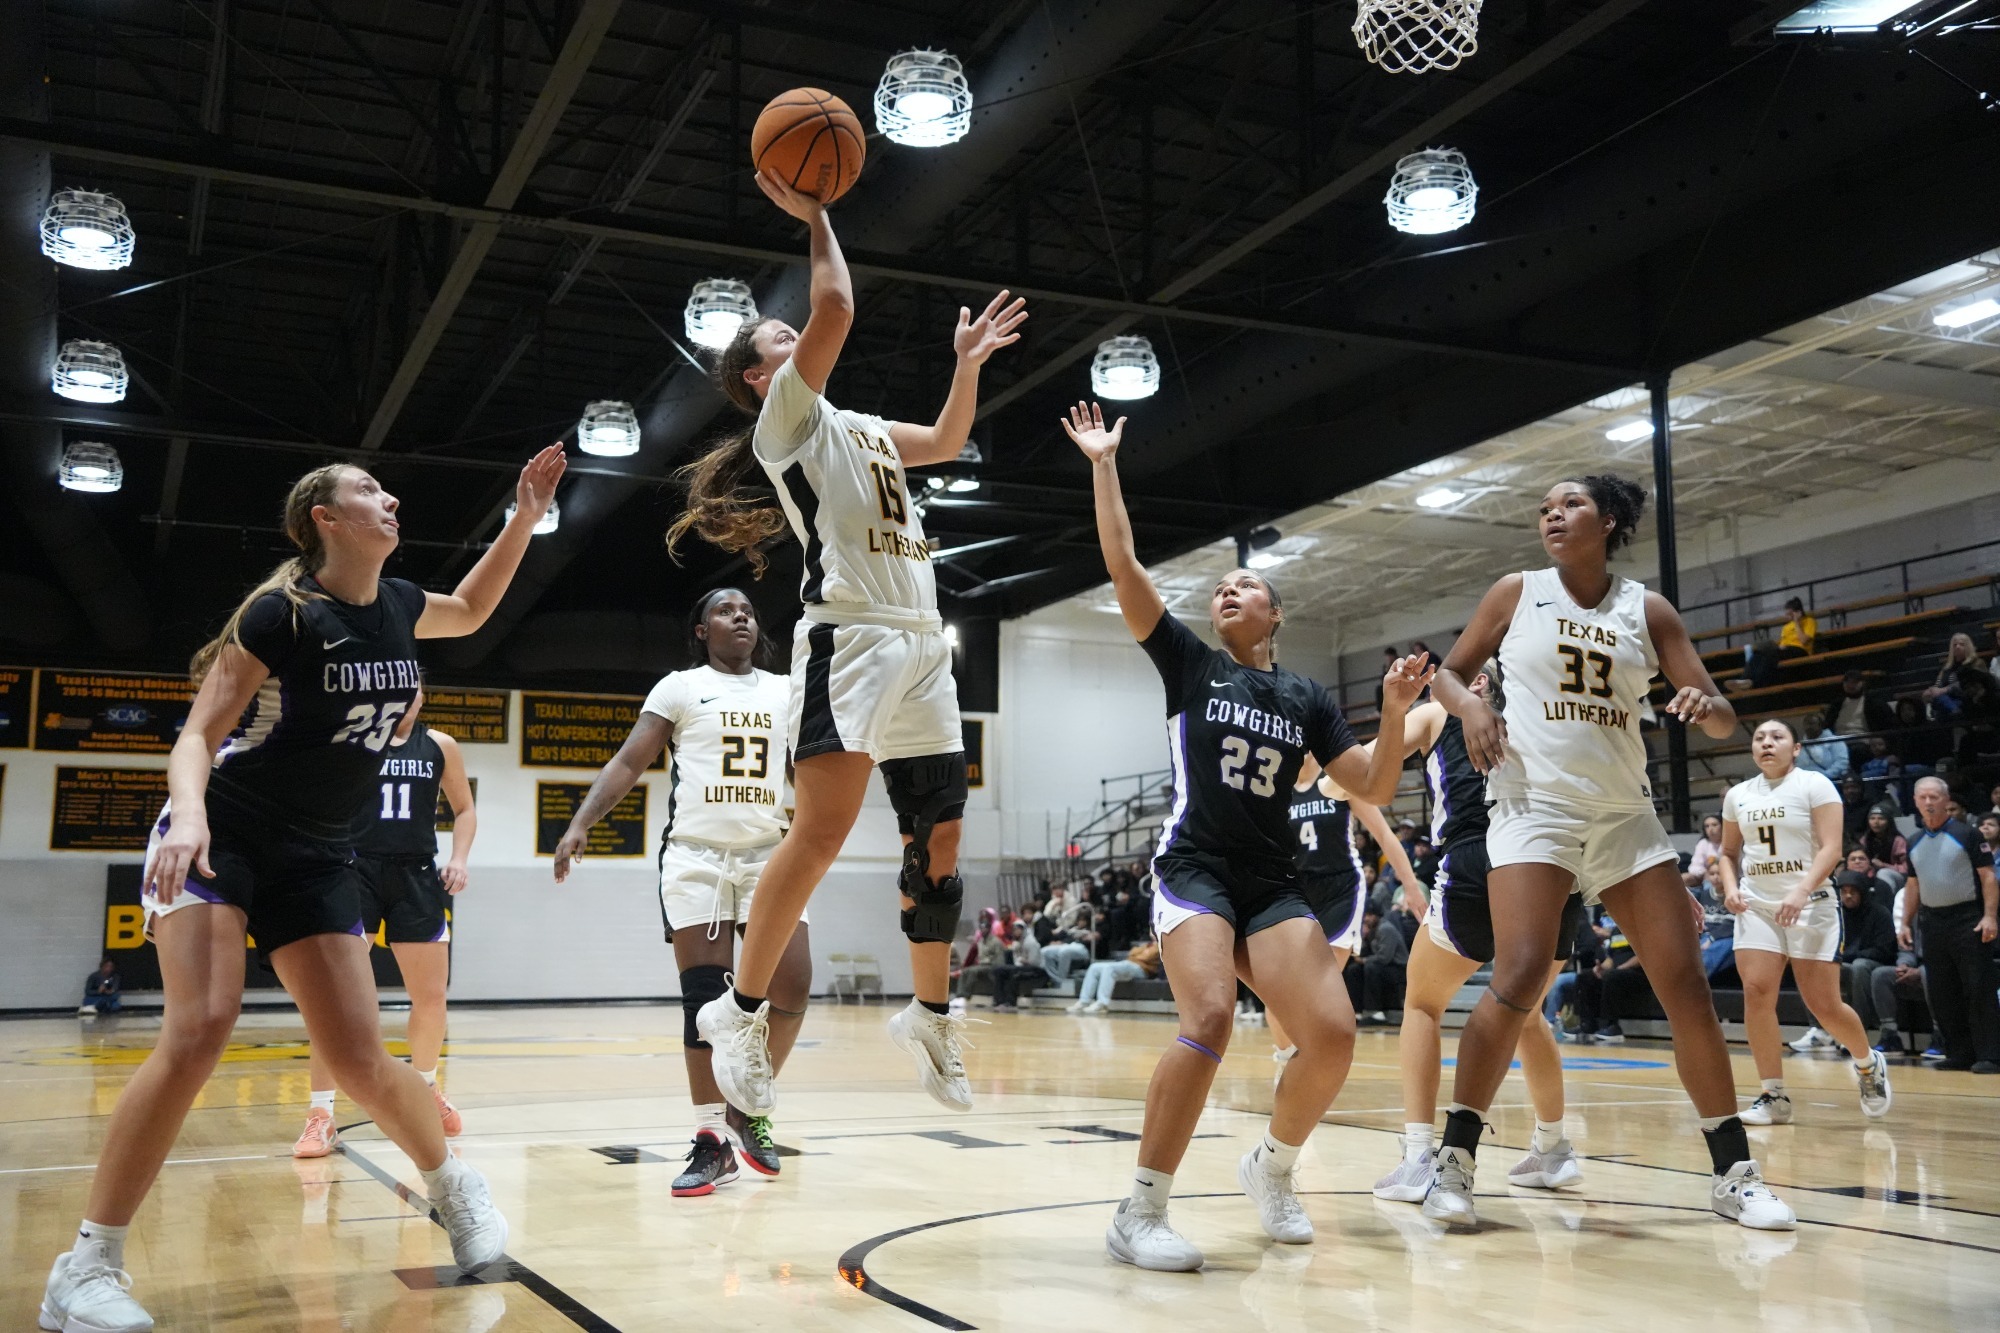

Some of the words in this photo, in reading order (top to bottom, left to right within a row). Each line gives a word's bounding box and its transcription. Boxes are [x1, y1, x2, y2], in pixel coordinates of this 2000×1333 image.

[871, 462, 907, 526] 15
[1556, 618, 1617, 647] TEXAS
[323, 659, 419, 693] COWGIRL
[1557, 644, 1614, 698] 33
[107, 708, 147, 722] SCAC
[331, 701, 408, 752] 25
[534, 702, 564, 719] TEXAS
[565, 704, 614, 721] LUTHERAN
[615, 706, 641, 722] COLL
[719, 711, 772, 729] TEXAS
[1205, 698, 1304, 748] COWGIRLS
[1543, 701, 1630, 731] LUTHERAN
[526, 724, 547, 740] HOT
[547, 726, 609, 742] CONFERENCE
[530, 746, 559, 760] MEN'S
[722, 735, 769, 779] 23
[1219, 735, 1284, 798] 23
[380, 782, 411, 819] 11
[705, 785, 776, 806] LUTHERAN
[1288, 799, 1336, 820] WGIRLS
[1747, 806, 1785, 823] TEXAS
[1299, 820, 1318, 851] 4
[1758, 825, 1776, 856] 4
[1746, 859, 1803, 876] LUTHERAN
